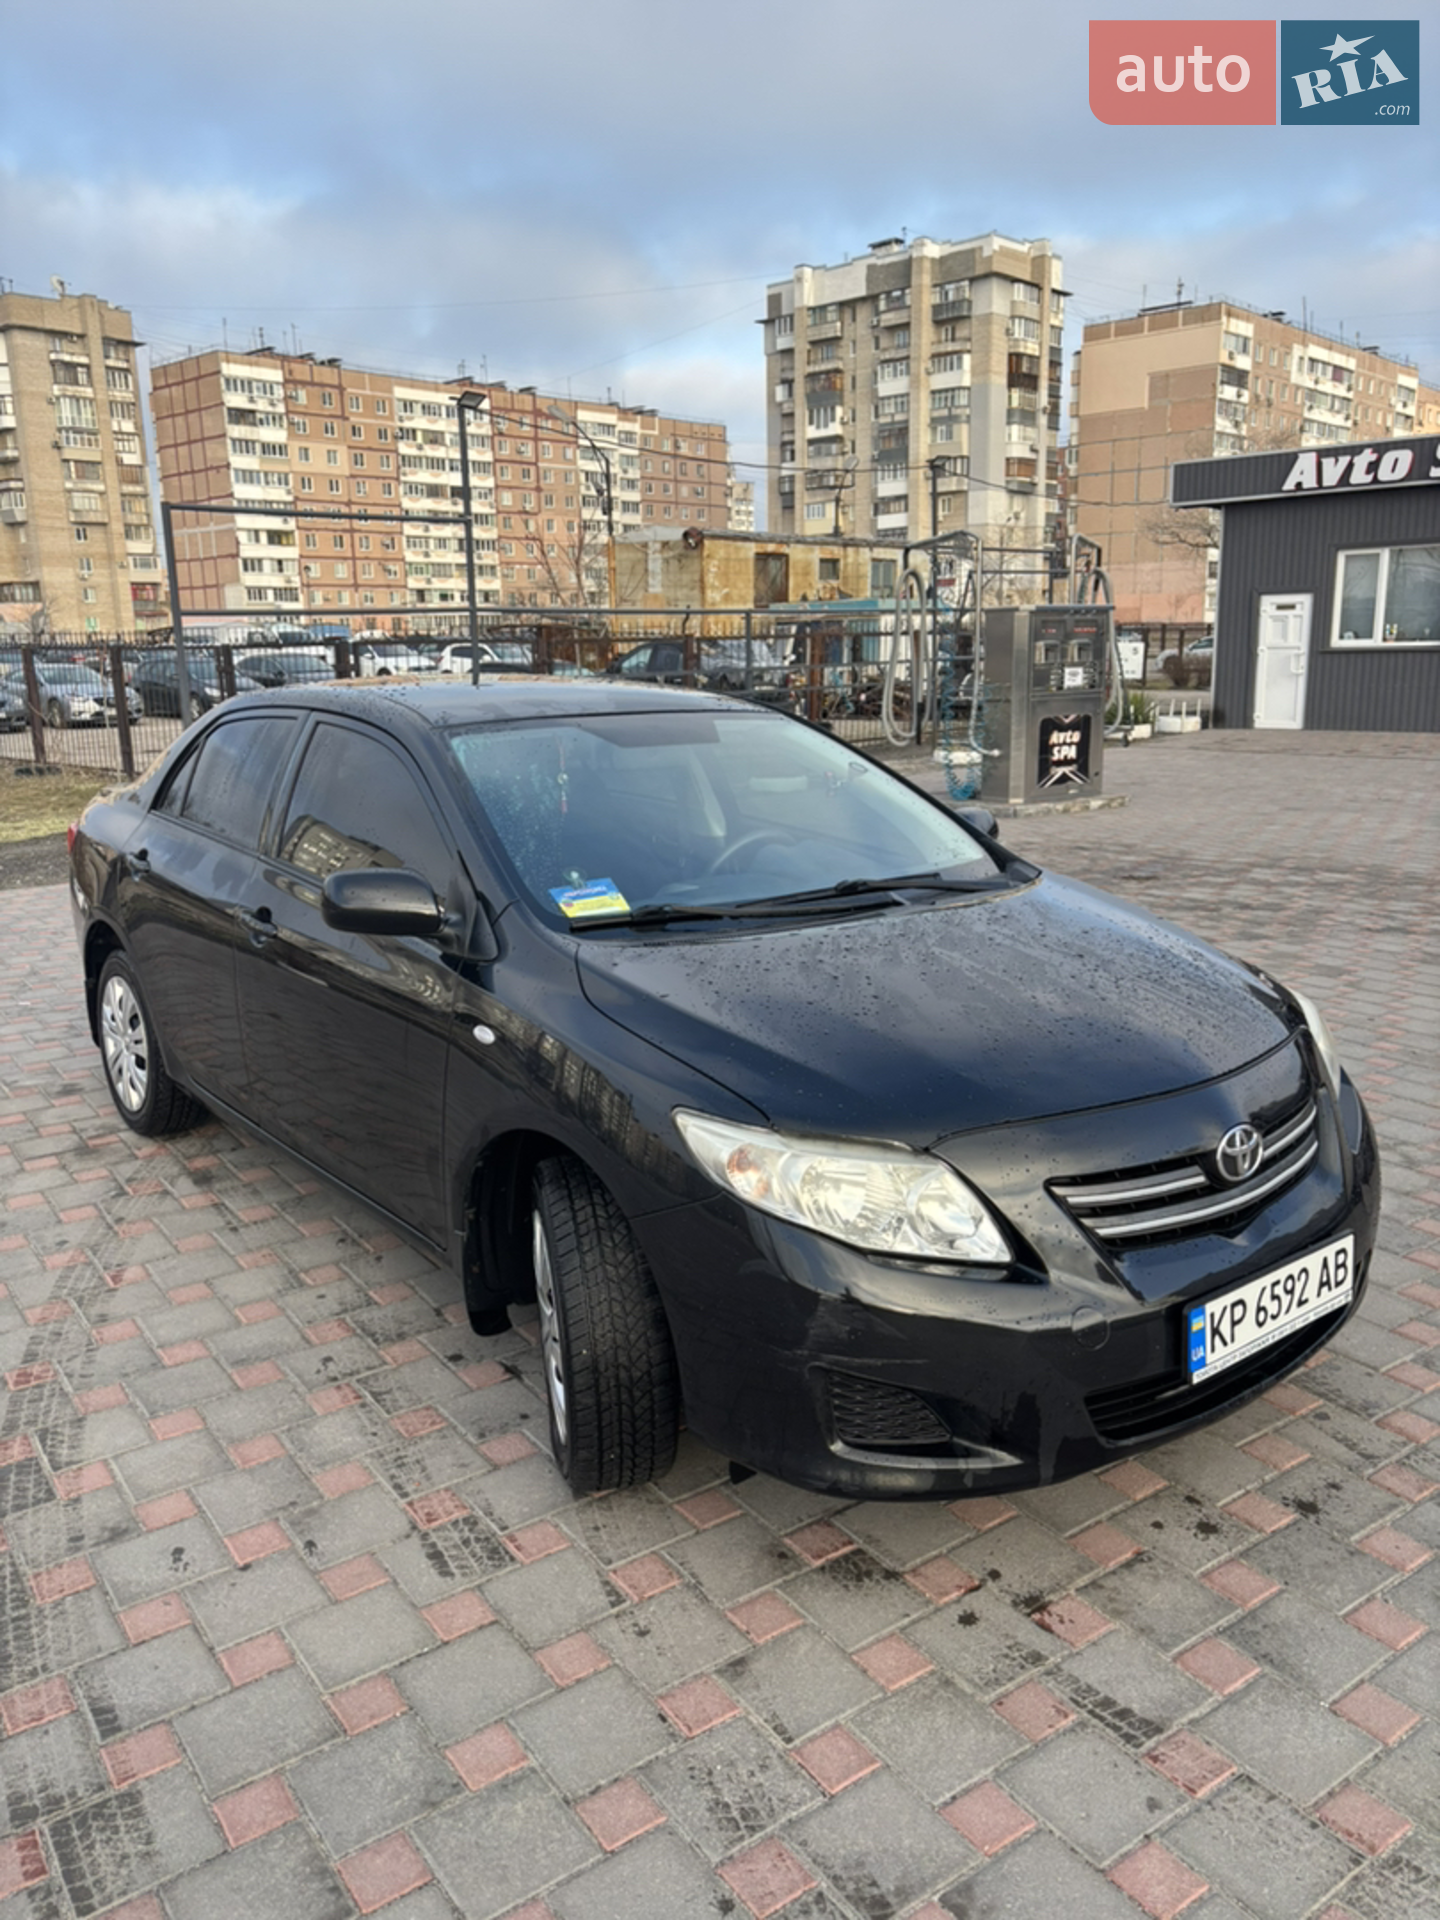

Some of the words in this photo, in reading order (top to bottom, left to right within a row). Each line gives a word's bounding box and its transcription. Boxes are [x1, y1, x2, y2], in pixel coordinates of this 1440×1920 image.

[1281, 448, 1414, 492] Avto
[1210, 1299, 1247, 1353] KP
[1255, 1267, 1309, 1328] 6592
[1316, 1248, 1348, 1298] AB
